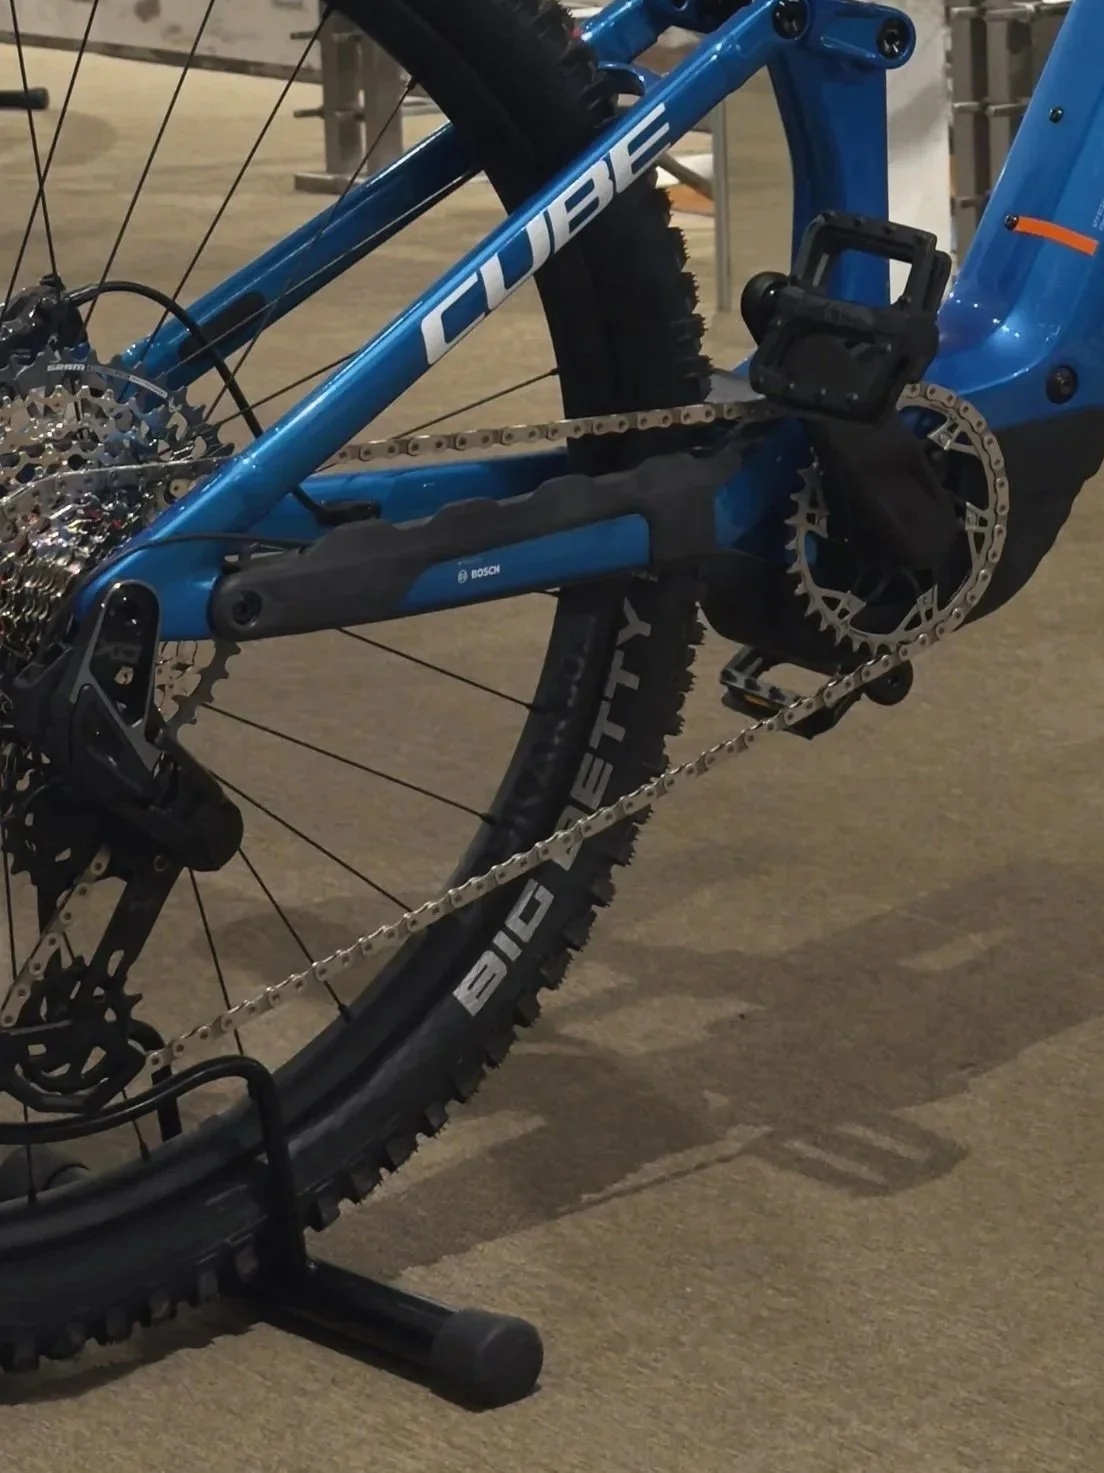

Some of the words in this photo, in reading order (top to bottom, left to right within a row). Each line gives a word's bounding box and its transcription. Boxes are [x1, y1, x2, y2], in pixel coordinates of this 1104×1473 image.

[421, 102, 672, 366] CUBE
[471, 564, 501, 580] BOSCH
[452, 878, 555, 1017] BIG
